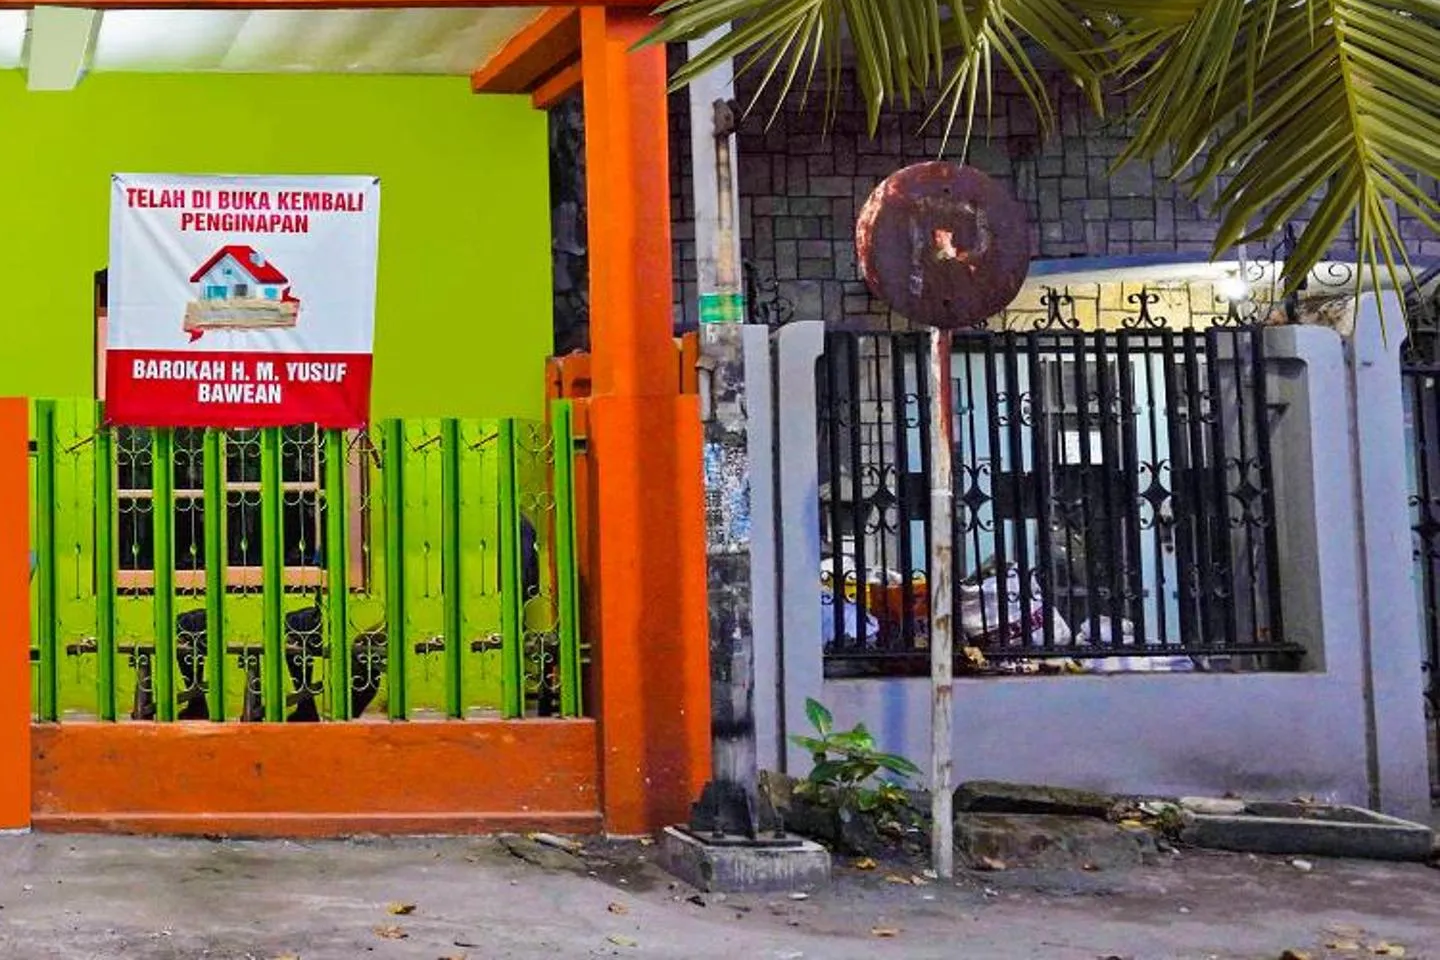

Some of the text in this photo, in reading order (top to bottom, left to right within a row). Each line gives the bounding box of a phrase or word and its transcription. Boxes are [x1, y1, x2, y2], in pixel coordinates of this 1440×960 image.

[126, 188, 364, 212] TELAH DI BUKA KEMBALI
[181, 212, 309, 233] PENGINAPAN
[132, 359, 347, 383] BAROKAH H. M. YUSUF
[197, 383, 282, 404] BAWEAN
